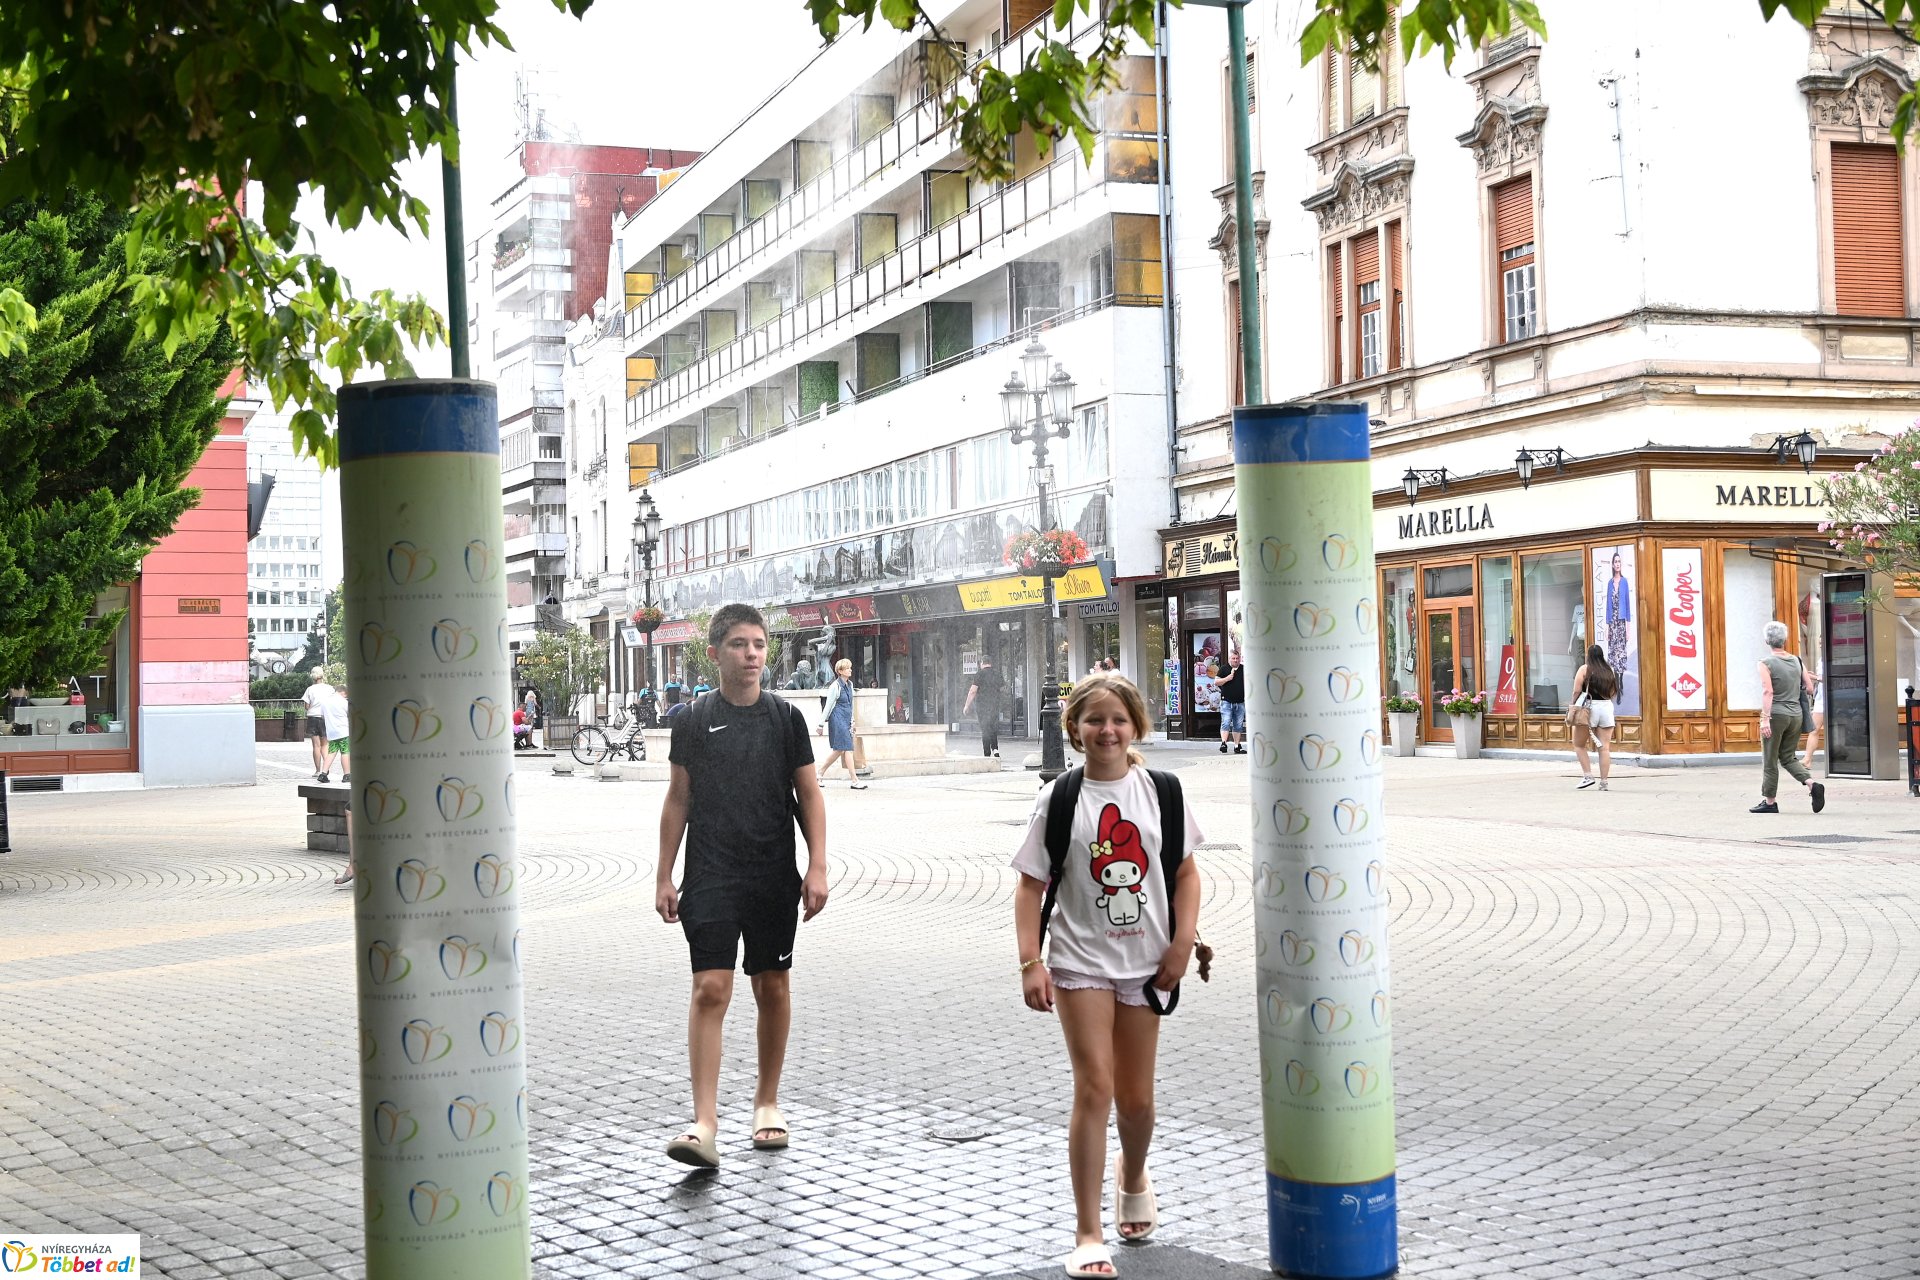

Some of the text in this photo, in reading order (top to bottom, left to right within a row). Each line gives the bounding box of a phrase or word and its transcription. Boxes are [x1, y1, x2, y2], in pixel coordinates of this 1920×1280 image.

[1716, 485, 1834, 508] MARELLA
[1398, 503, 1494, 540] MARELLA
[968, 585, 992, 607] bugatti
[1669, 562, 1700, 658] Lee Cooper
[420, 670, 484, 679] NYÍREGYHÁZA
[382, 752, 448, 760] NYÍREGYHÁZA
[425, 828, 489, 838] NYÍREGYHÁZA
[386, 911, 452, 920] NYÍREGYHÁZA
[430, 986, 494, 998] NYÍREGYHÁZA
[392, 1070, 458, 1081] NYÍREGYHÁZA
[438, 1146, 500, 1159] NYÍREGYHÁZA
[400, 1233, 466, 1242] NYÍREGYHÁZA
